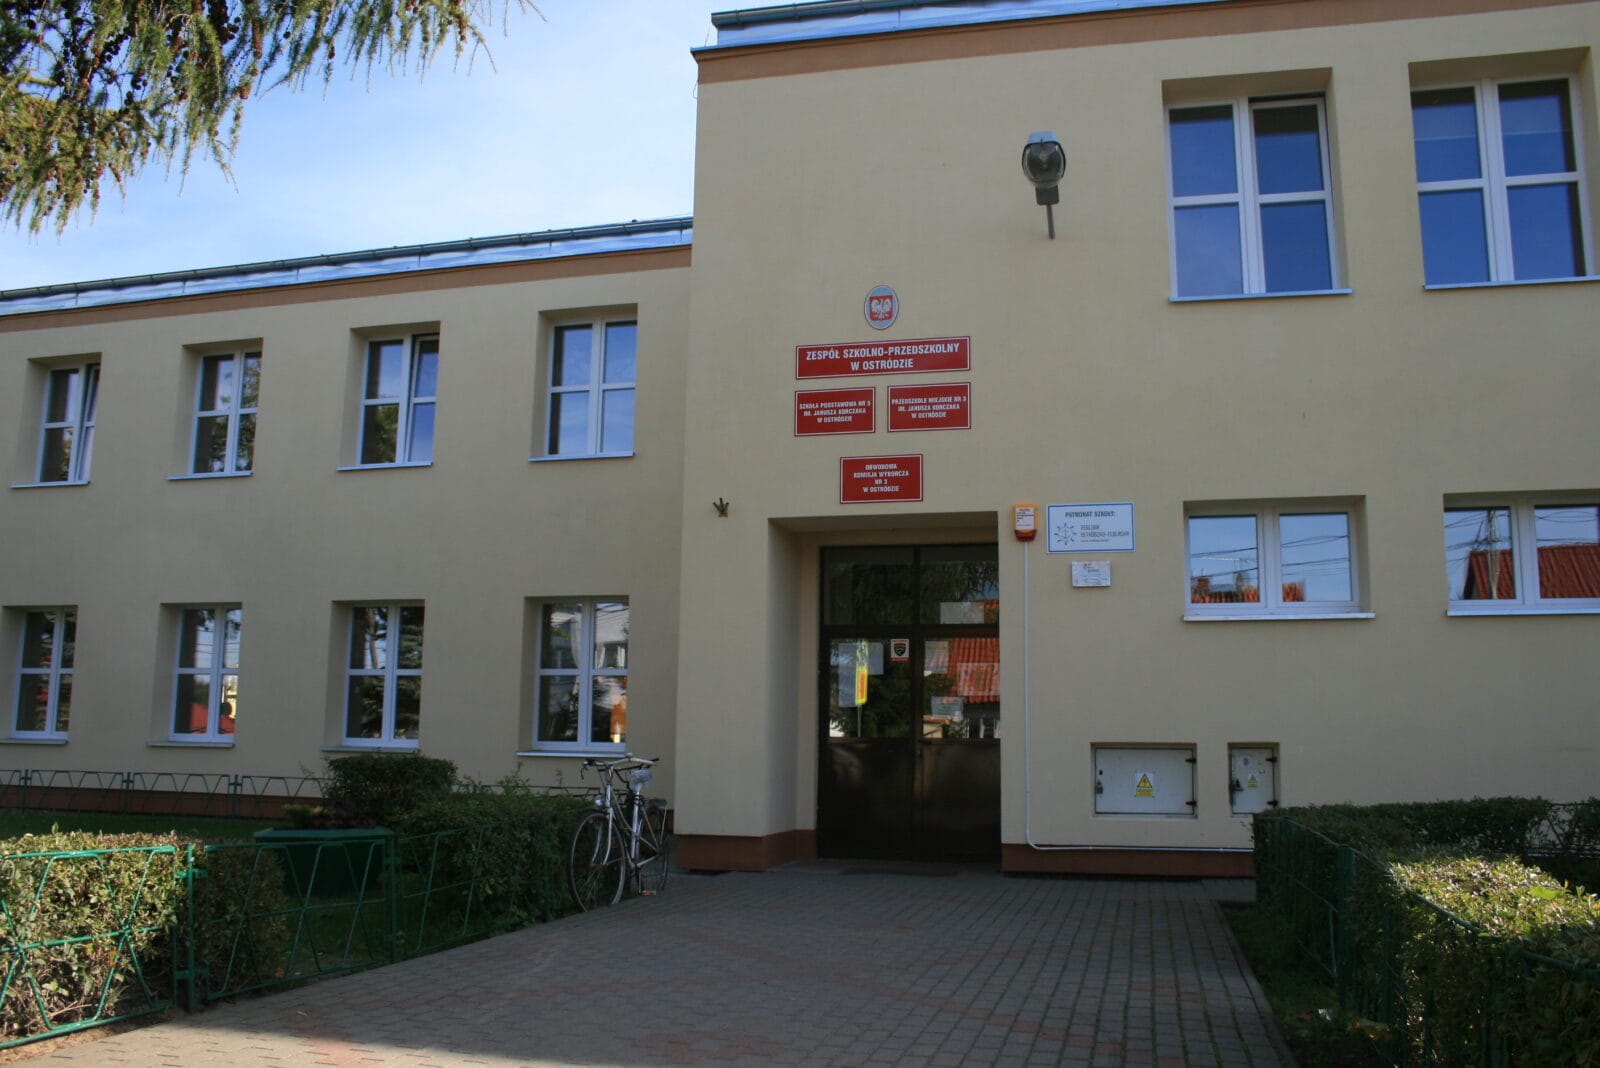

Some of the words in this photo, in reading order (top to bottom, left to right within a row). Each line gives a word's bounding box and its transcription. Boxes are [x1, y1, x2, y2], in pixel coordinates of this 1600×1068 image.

[806, 349, 840, 361] ZESPÓŁ
[843, 343, 960, 359] SZKOLNO-PRZEDSZKOLNY
[851, 361, 860, 371] W
[862, 358, 914, 370] OSTRÓDZIE
